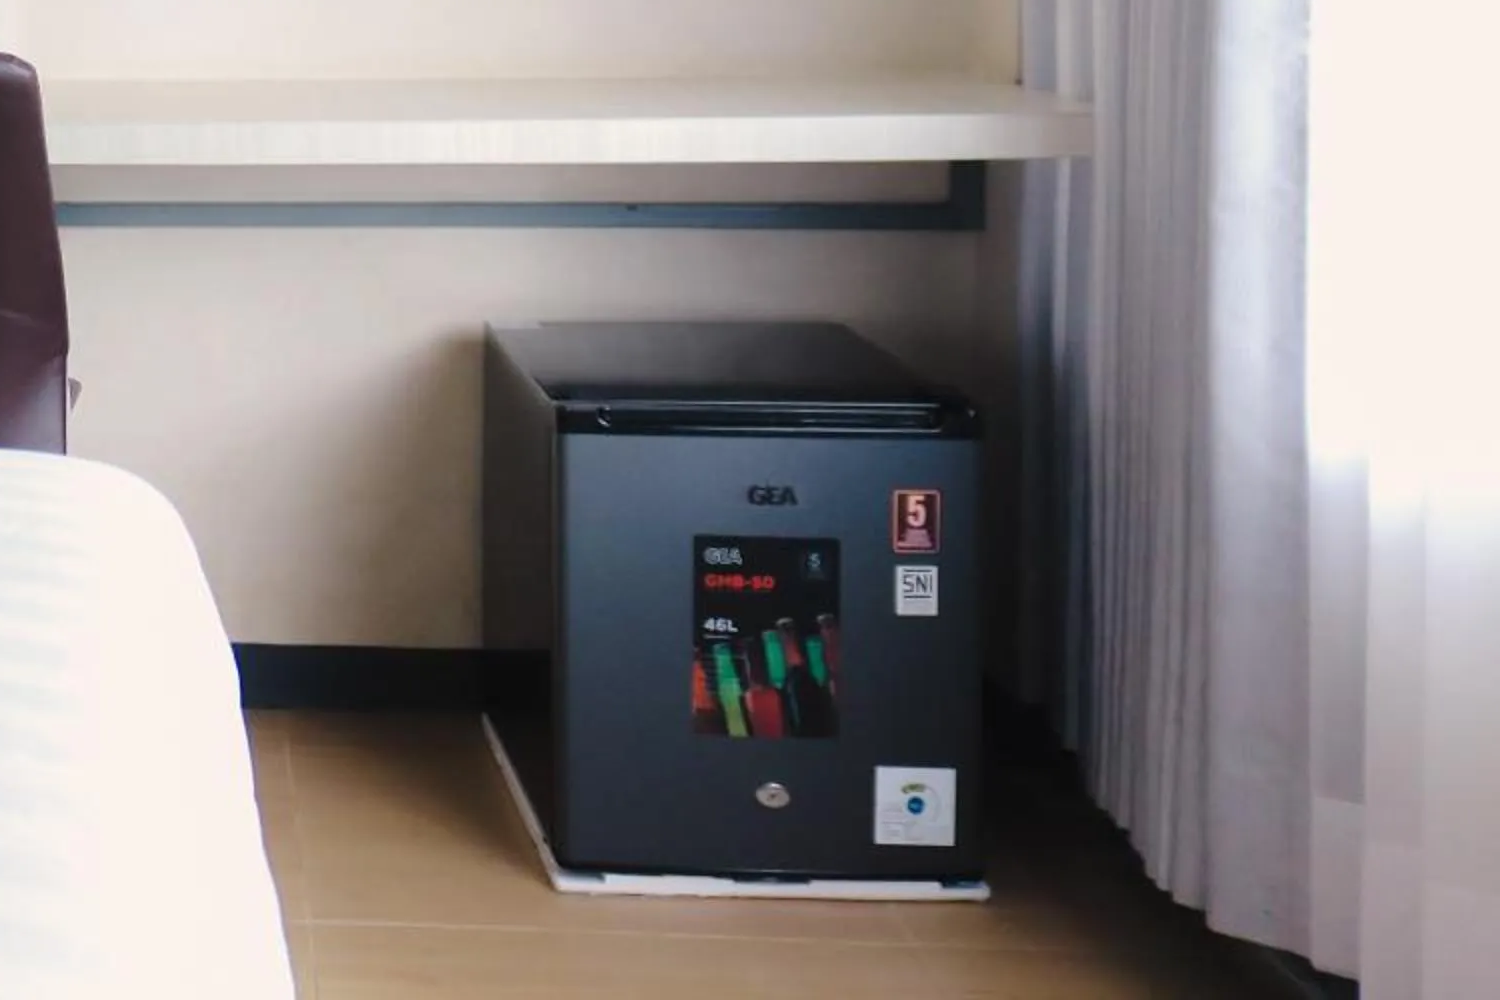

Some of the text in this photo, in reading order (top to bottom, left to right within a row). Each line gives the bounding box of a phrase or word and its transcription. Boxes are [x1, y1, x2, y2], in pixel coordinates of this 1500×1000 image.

[746, 485, 798, 506] GEA
[906, 494, 927, 528] 5
[903, 573, 933, 594] SNI
[703, 616, 739, 633] 46L
